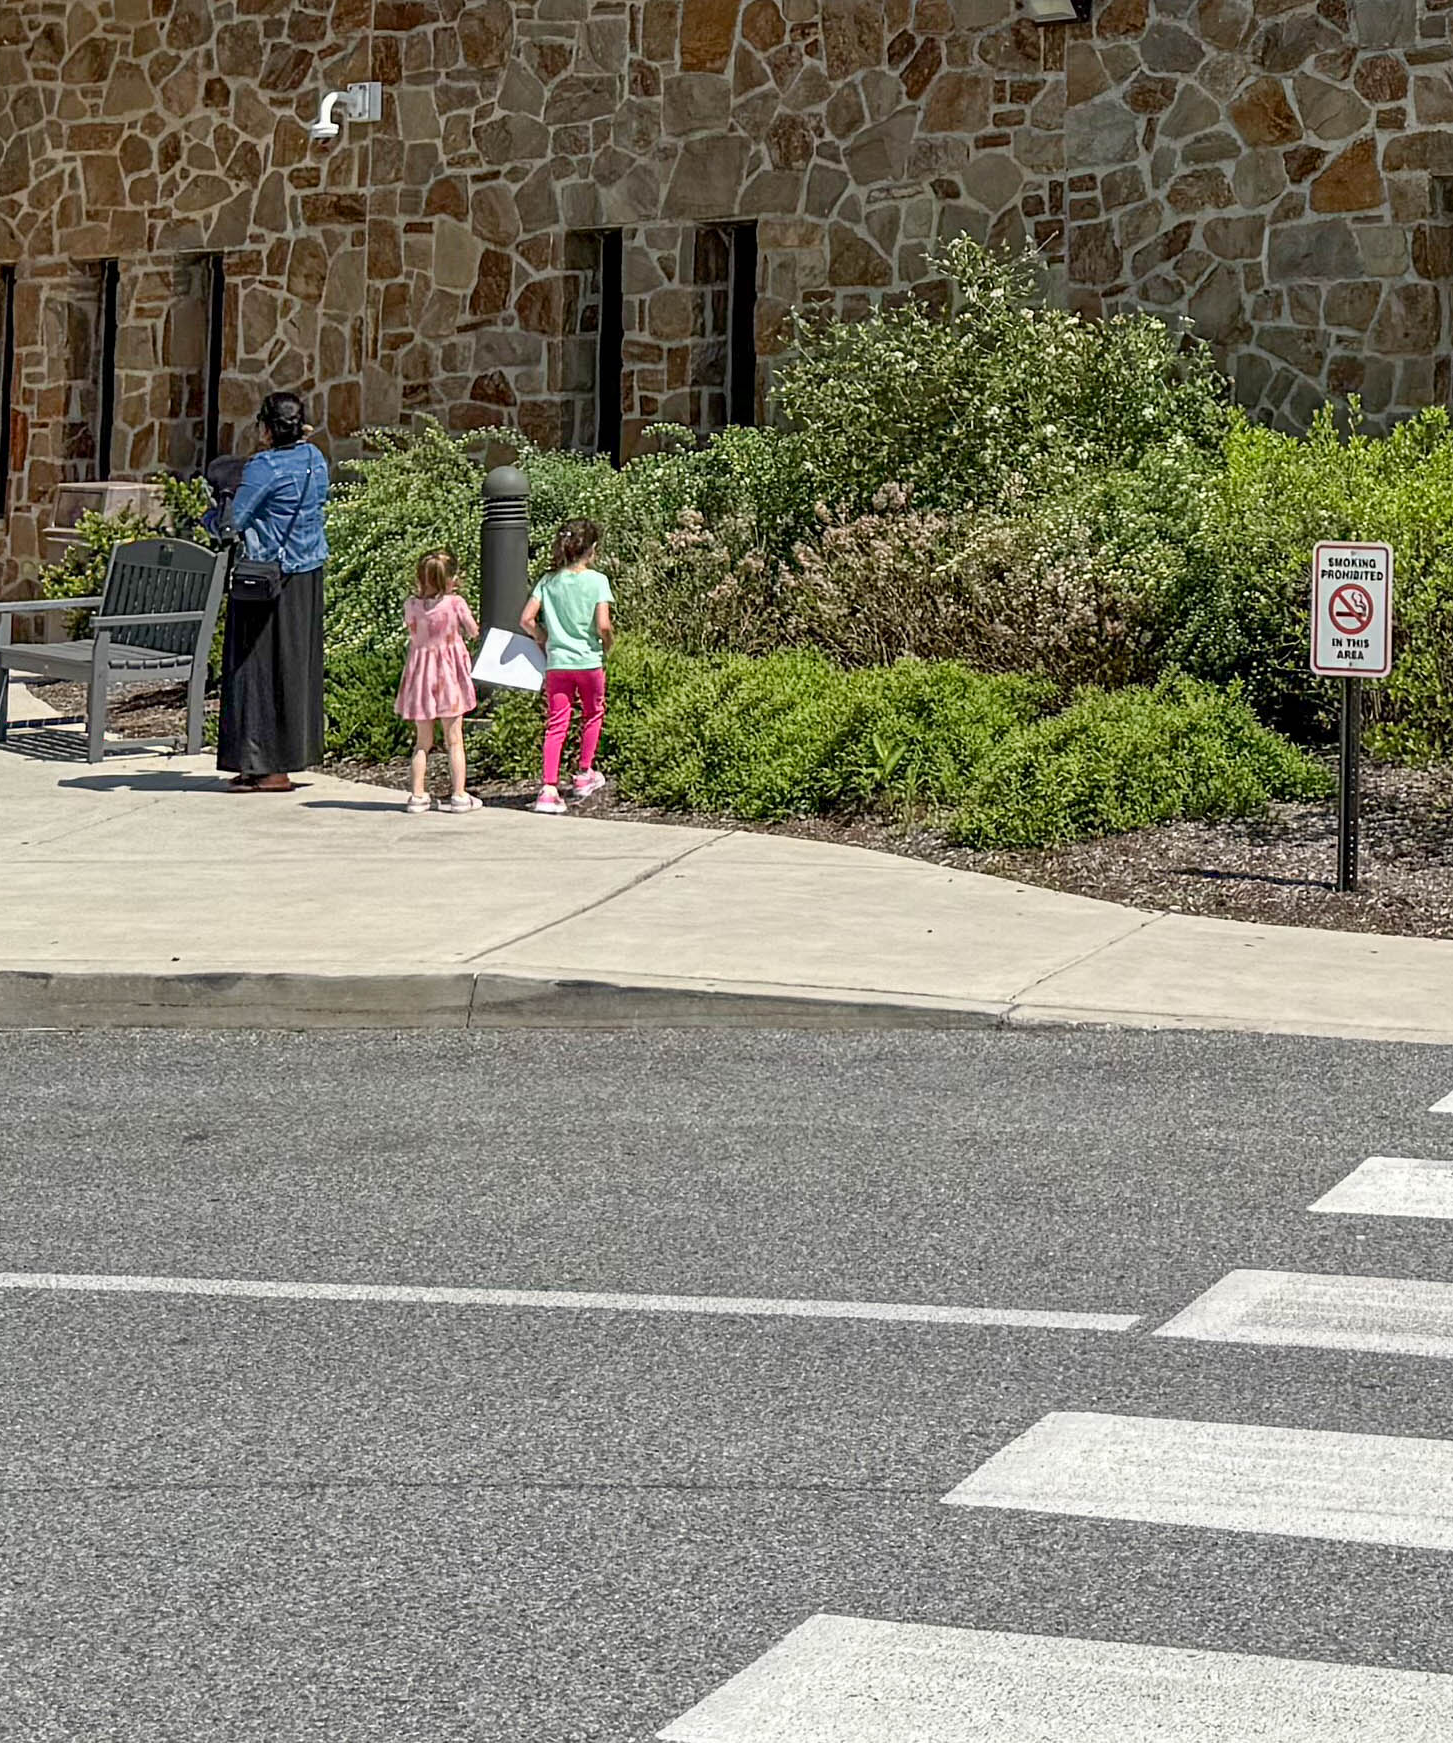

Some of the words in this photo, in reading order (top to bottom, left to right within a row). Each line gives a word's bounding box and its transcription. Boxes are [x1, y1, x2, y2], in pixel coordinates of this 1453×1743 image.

[1328, 557, 1377, 569] SMOKING
[1321, 569, 1384, 581] PROHIBITED
[1331, 638, 1343, 647] IN
[1346, 638, 1370, 649] THIS
[1336, 650, 1364, 661] AREA
